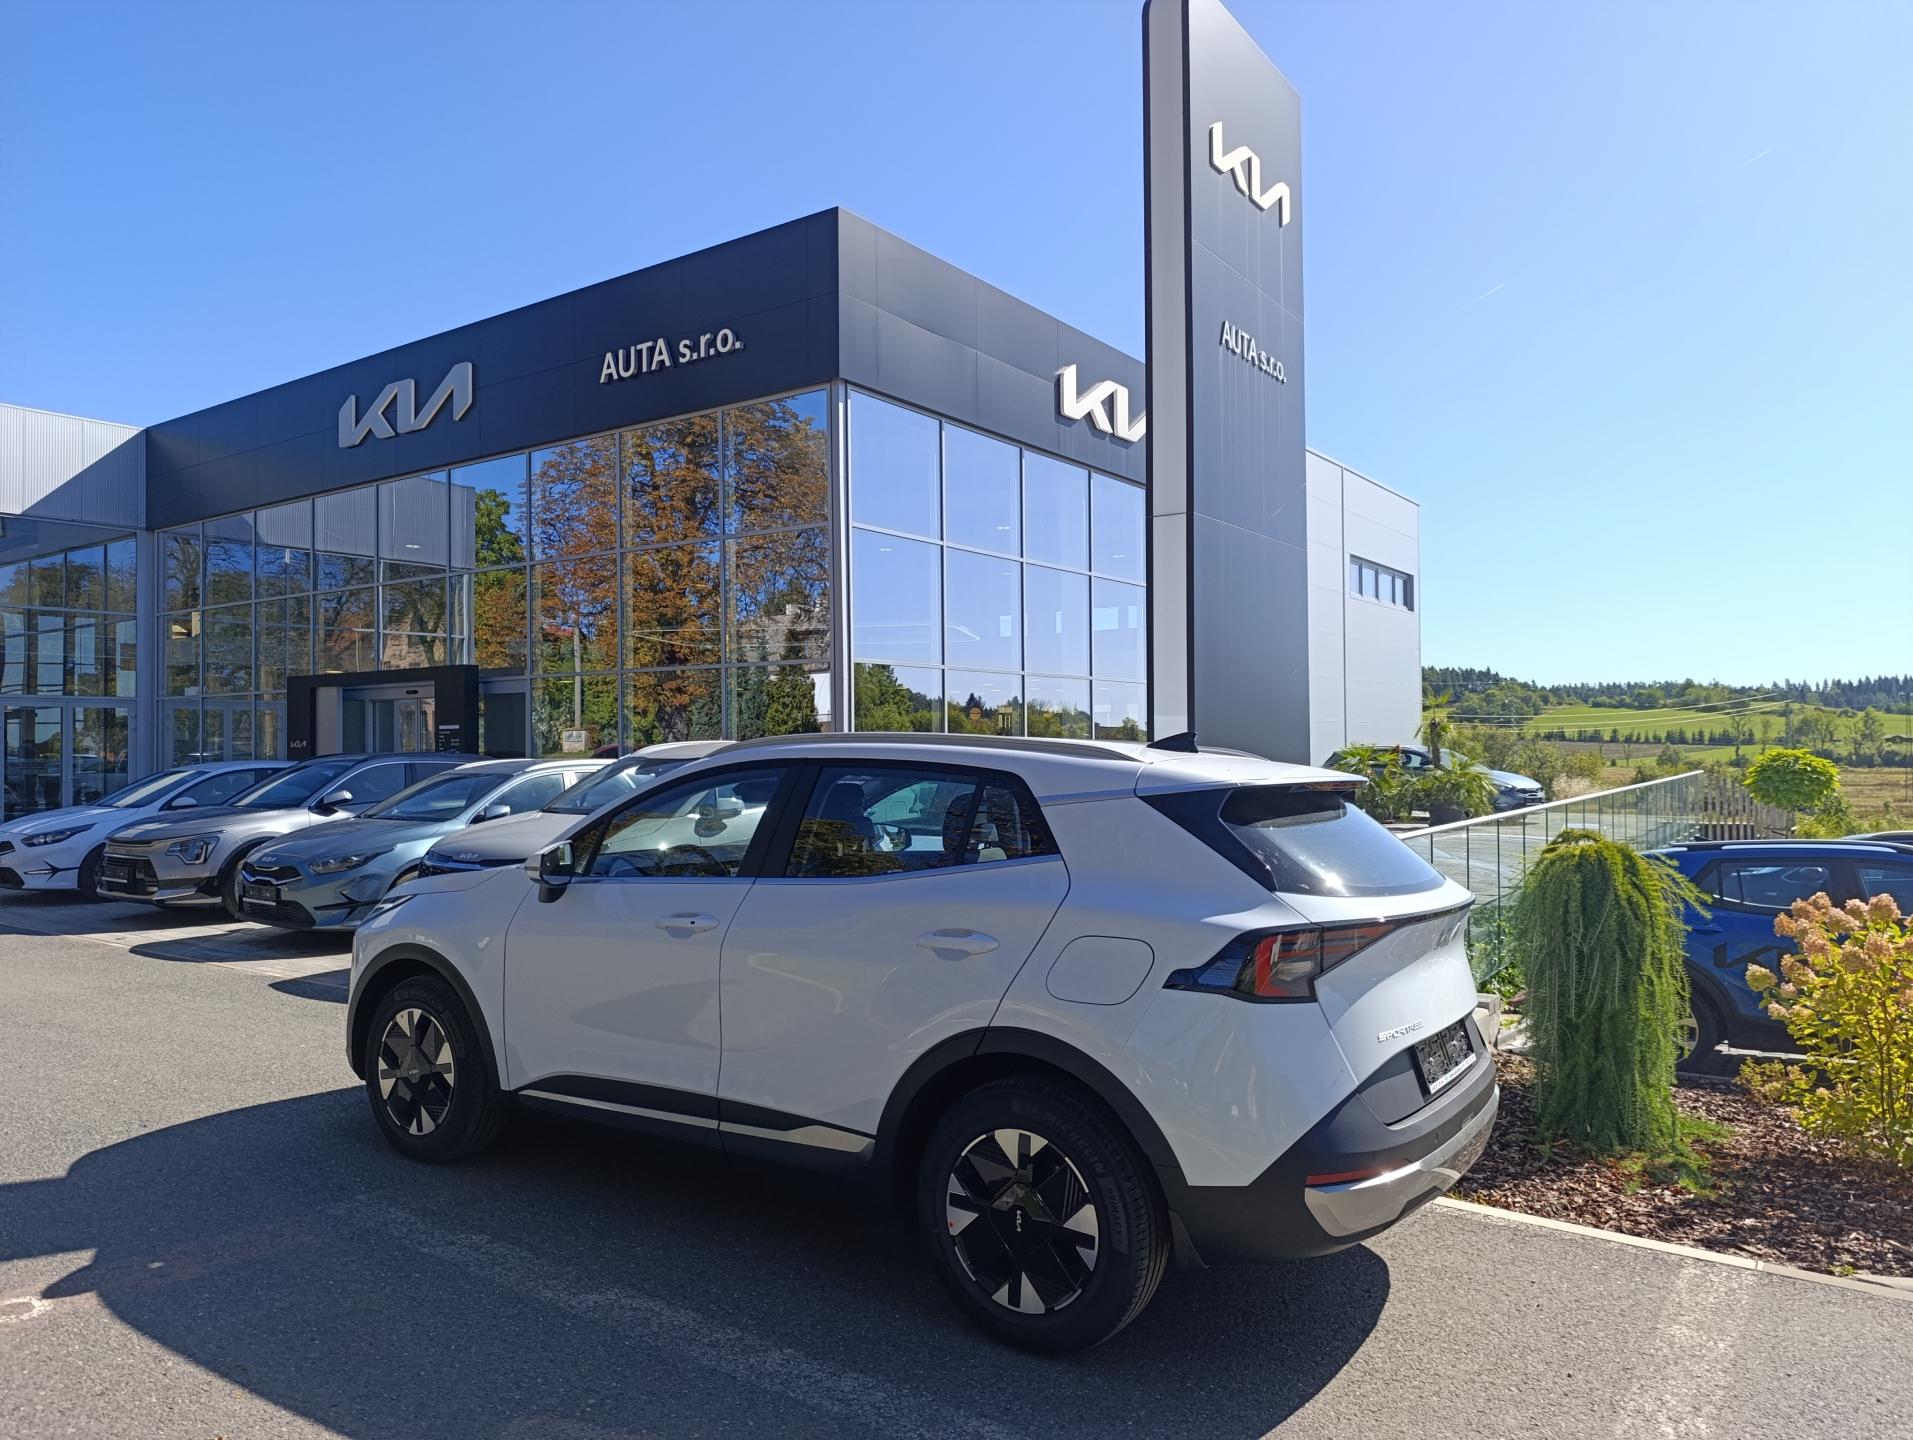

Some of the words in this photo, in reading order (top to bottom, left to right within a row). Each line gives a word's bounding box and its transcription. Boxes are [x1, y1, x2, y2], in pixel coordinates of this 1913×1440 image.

[1209, 120, 1290, 228] KIA
[600, 338, 673, 383] AUTA
[679, 328, 743, 363] s.r.o.
[1219, 320, 1258, 366] AUTA
[1258, 350, 1287, 384] s.r.o.
[338, 361, 473, 448] KIA
